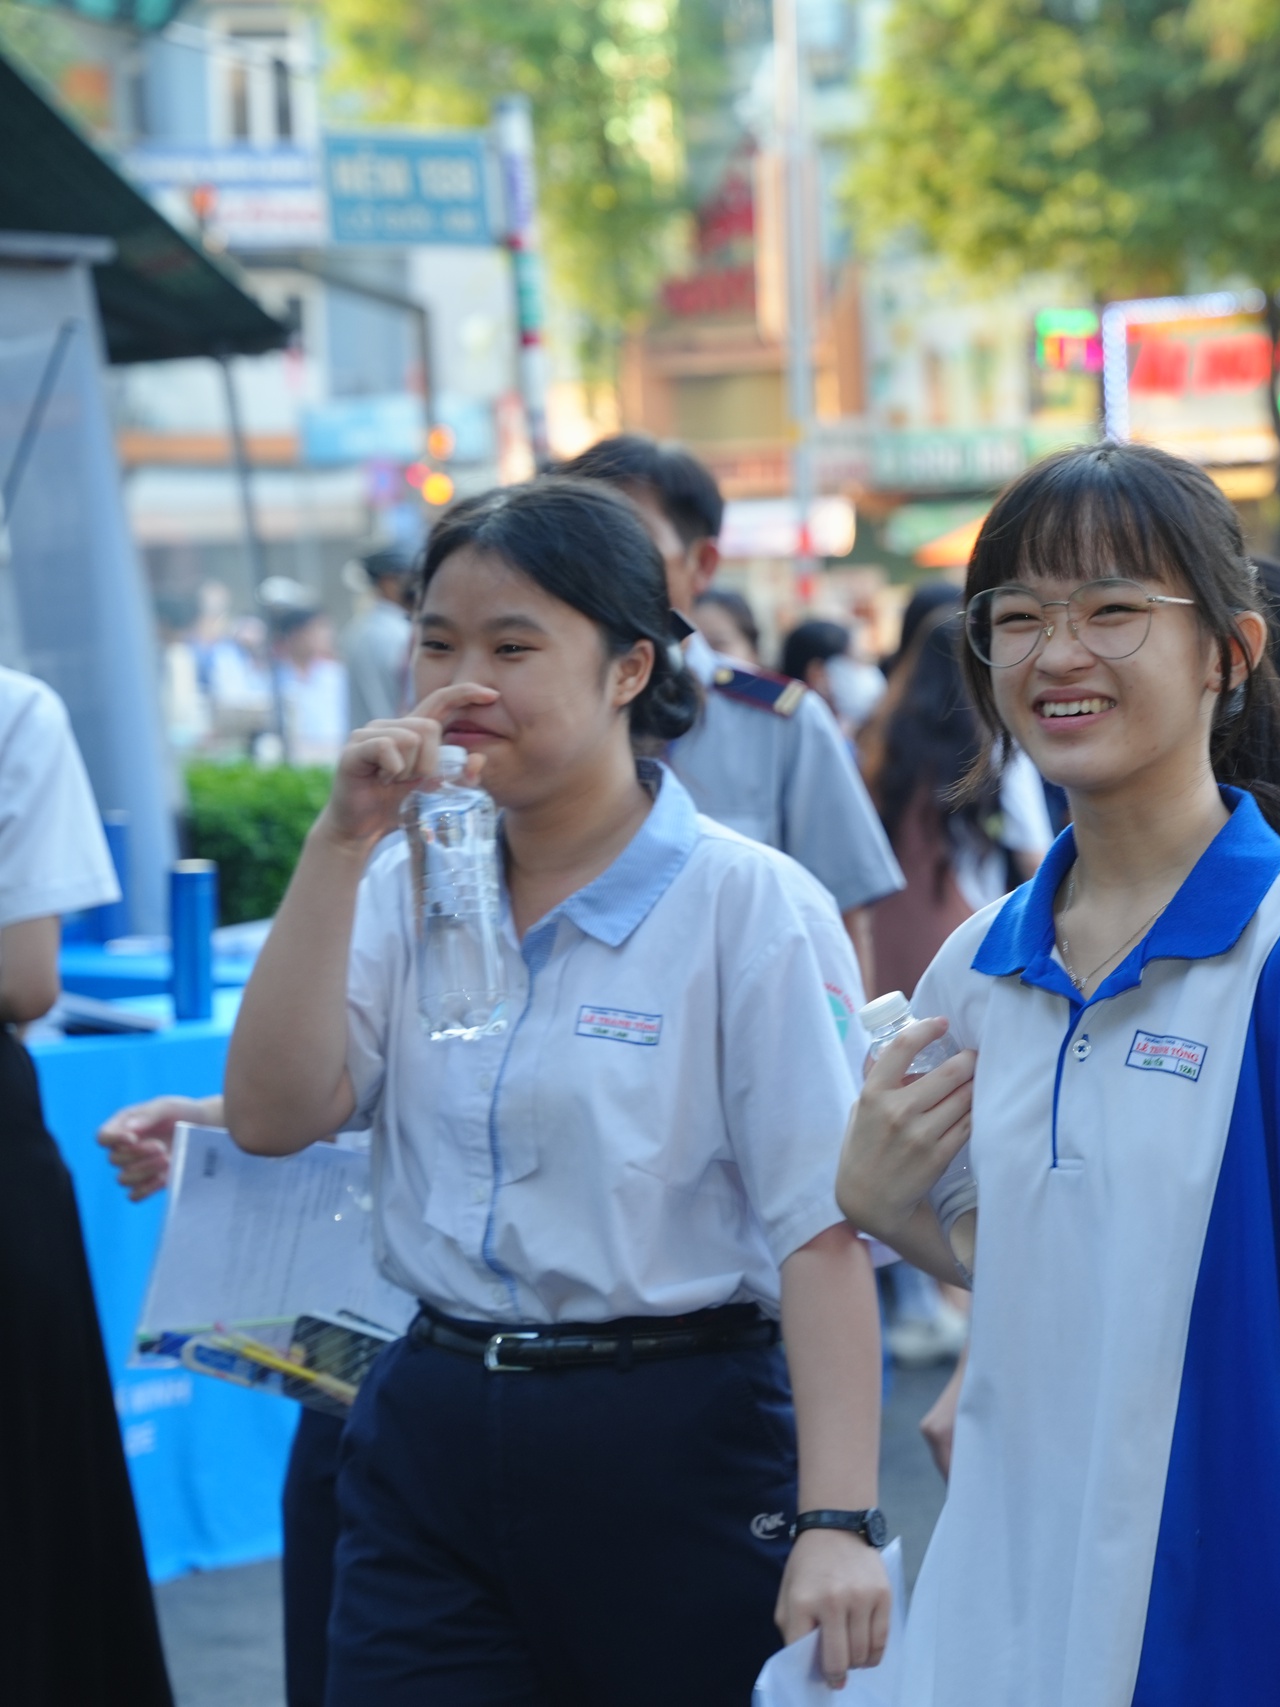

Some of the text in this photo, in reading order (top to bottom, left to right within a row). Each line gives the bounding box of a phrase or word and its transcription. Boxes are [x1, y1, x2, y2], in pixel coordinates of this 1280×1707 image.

[1136, 1042, 1149, 1052] LÊ
[1171, 1047, 1199, 1062] TÔNG
[1180, 1064, 1197, 1077] 12A1
